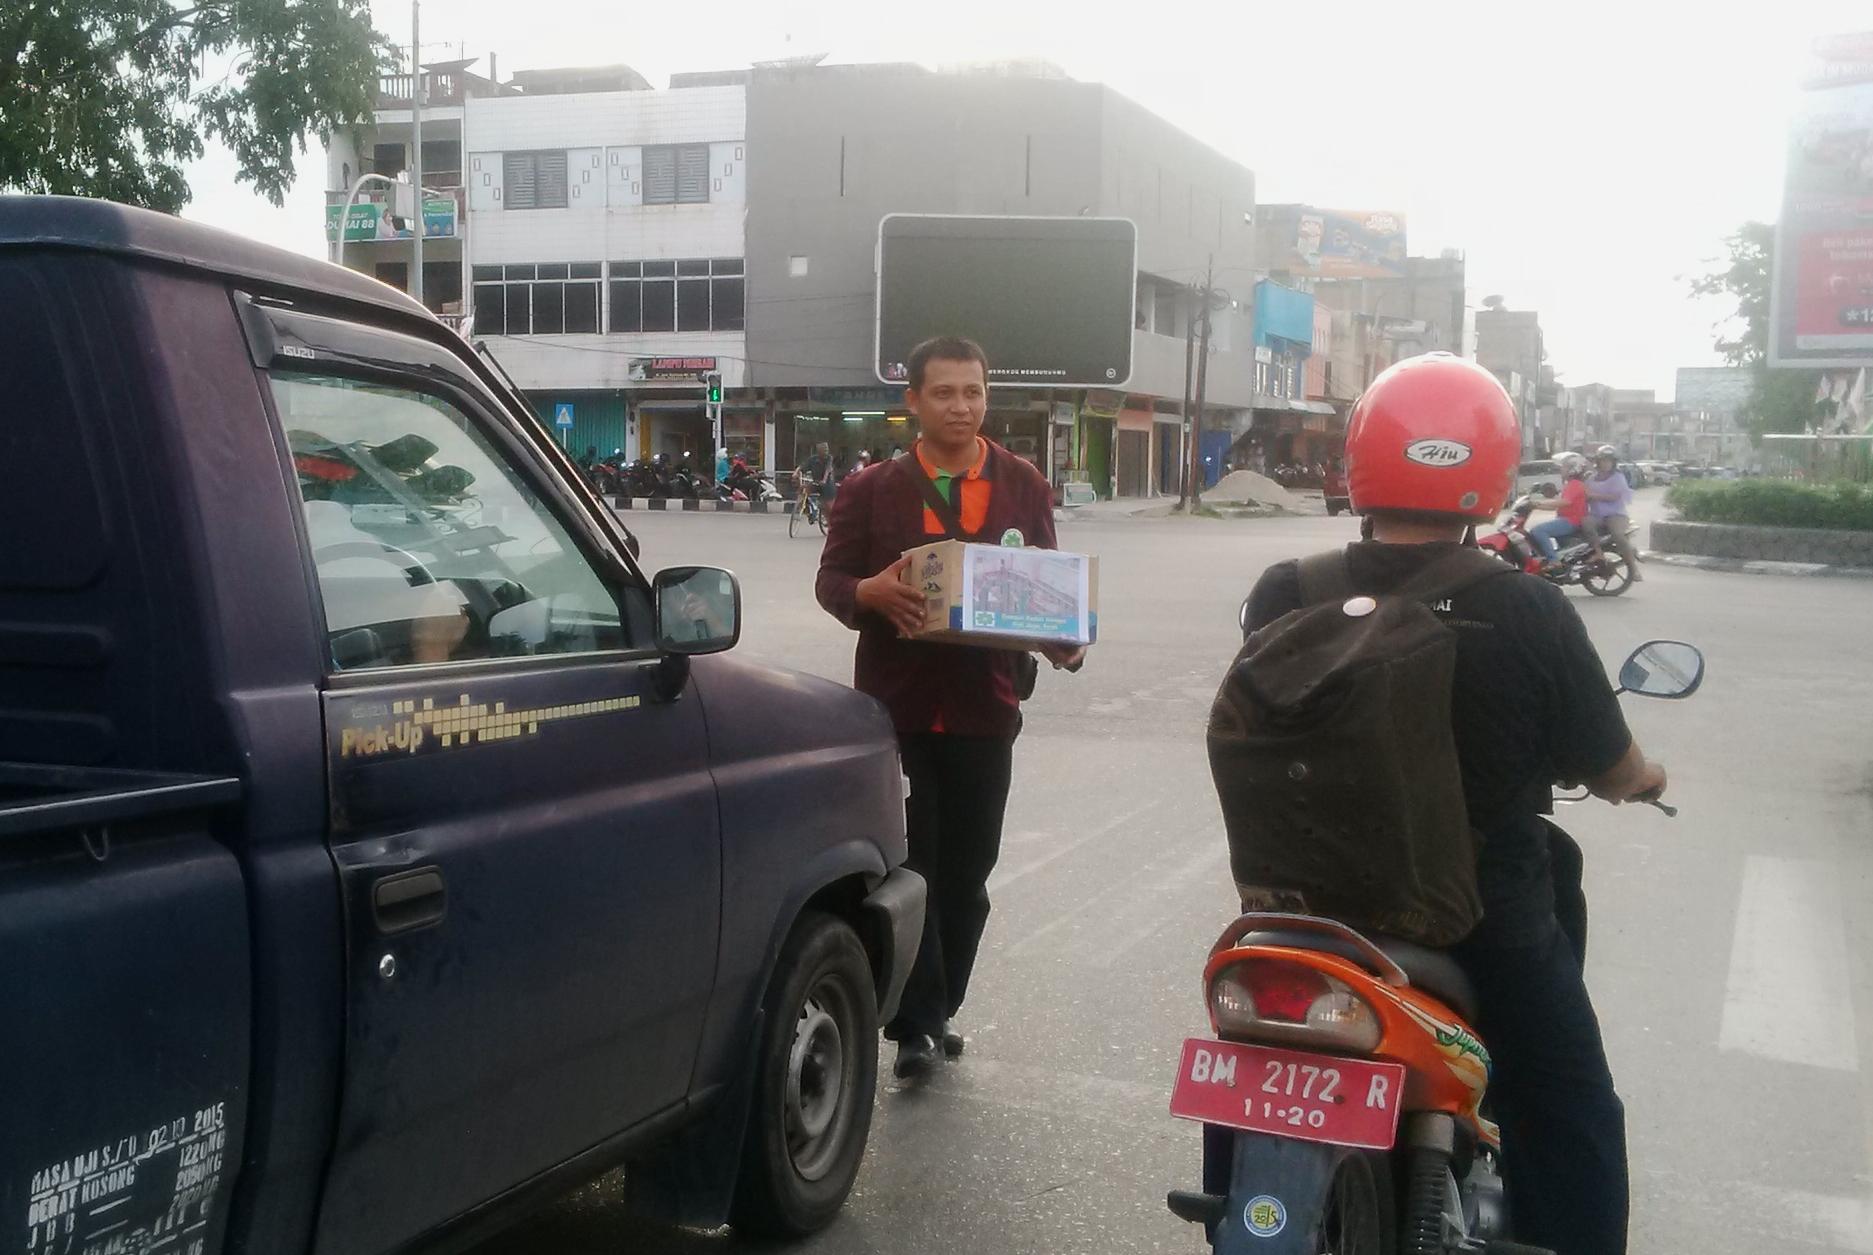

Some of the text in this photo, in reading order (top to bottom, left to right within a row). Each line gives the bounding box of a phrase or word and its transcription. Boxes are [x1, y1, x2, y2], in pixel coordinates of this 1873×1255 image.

[362, 218, 375, 229] 88
[283, 345, 315, 360] ISUZU
[1418, 445, 1459, 461] Hiu
[341, 719, 424, 758] Pick-Up
[1191, 1049, 1389, 1110] BM 2172 R
[194, 1102, 225, 1133] 2015
